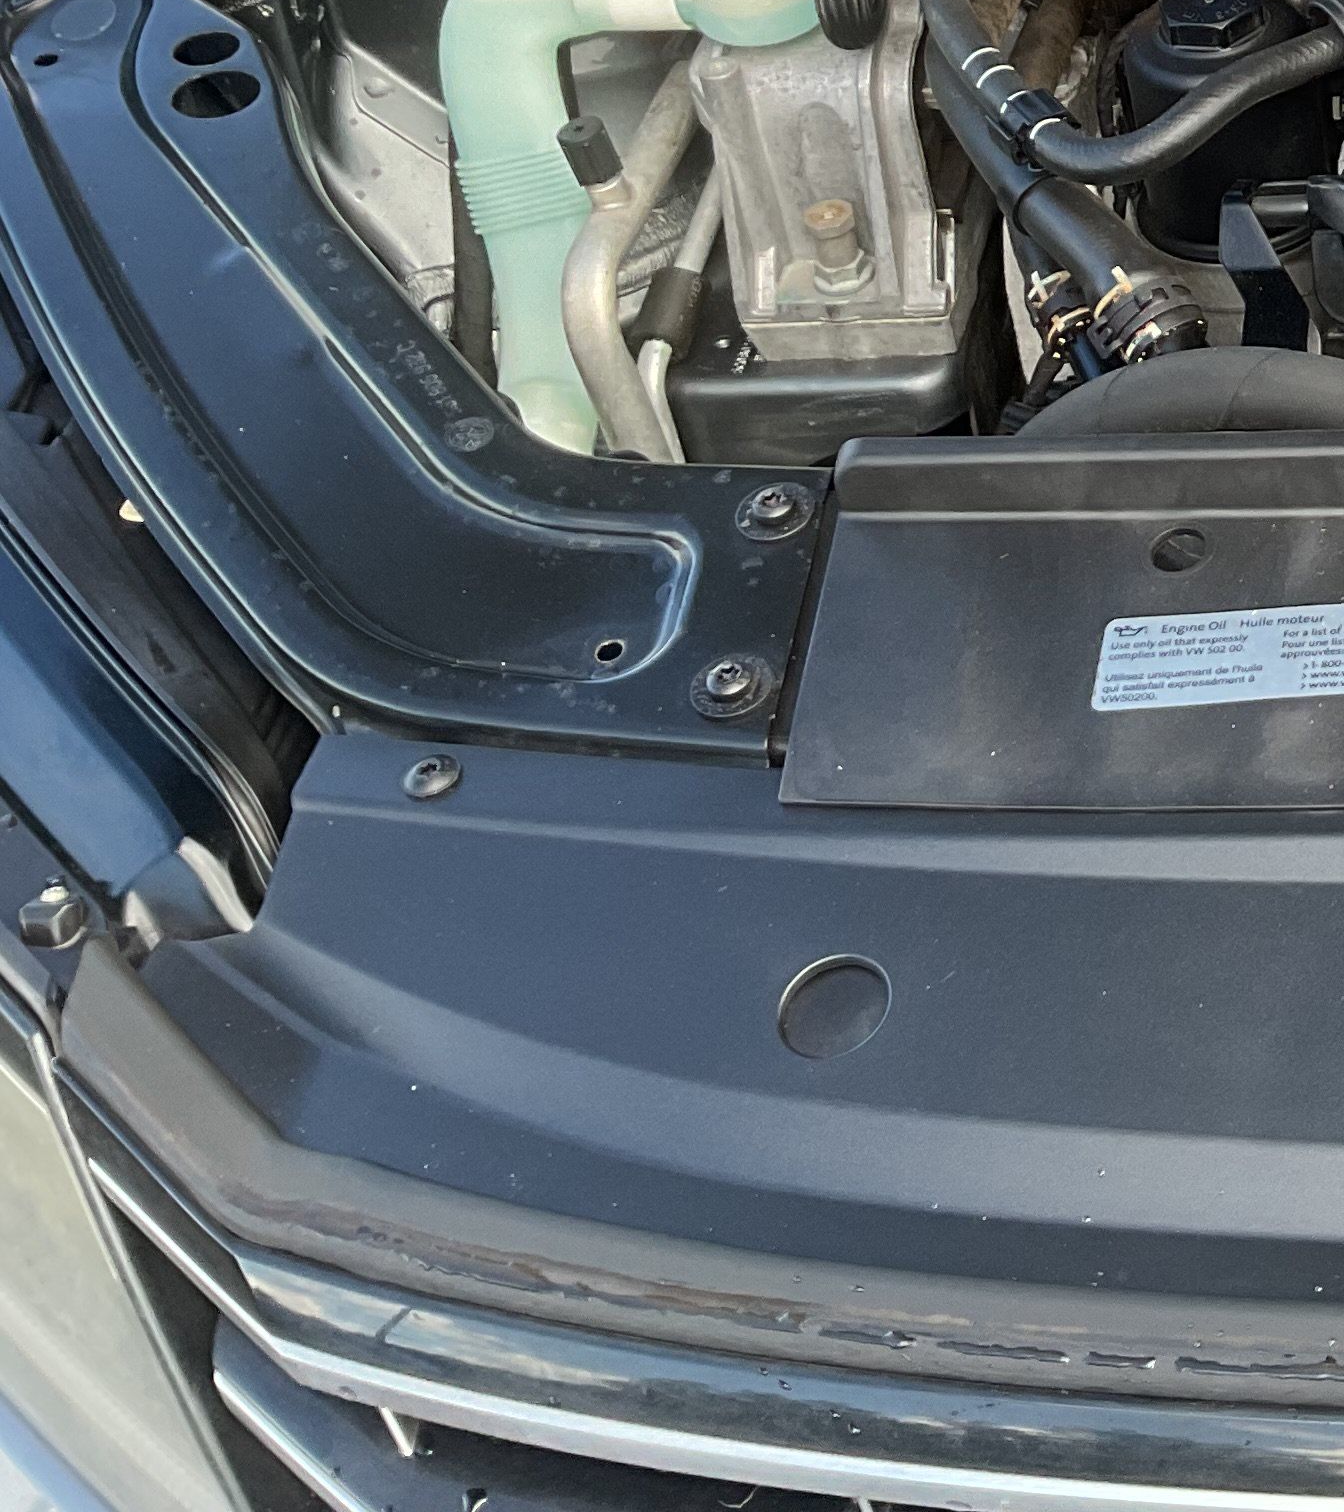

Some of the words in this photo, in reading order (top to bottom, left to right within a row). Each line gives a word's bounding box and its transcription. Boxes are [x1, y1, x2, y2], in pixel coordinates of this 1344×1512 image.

[1160, 621, 1207, 636] Engine
[1207, 619, 1227, 630] Oil
[1239, 616, 1275, 628] Huile
[1276, 612, 1324, 625] moteur
[1110, 641, 1131, 650] Use
[1133, 639, 1155, 649] only
[1198, 633, 1249, 644] expressly
[1107, 650, 1156, 661] complies
[1158, 648, 1183, 658] with
[1184, 647, 1205, 656] VW
[1207, 645, 1227, 654] 502
